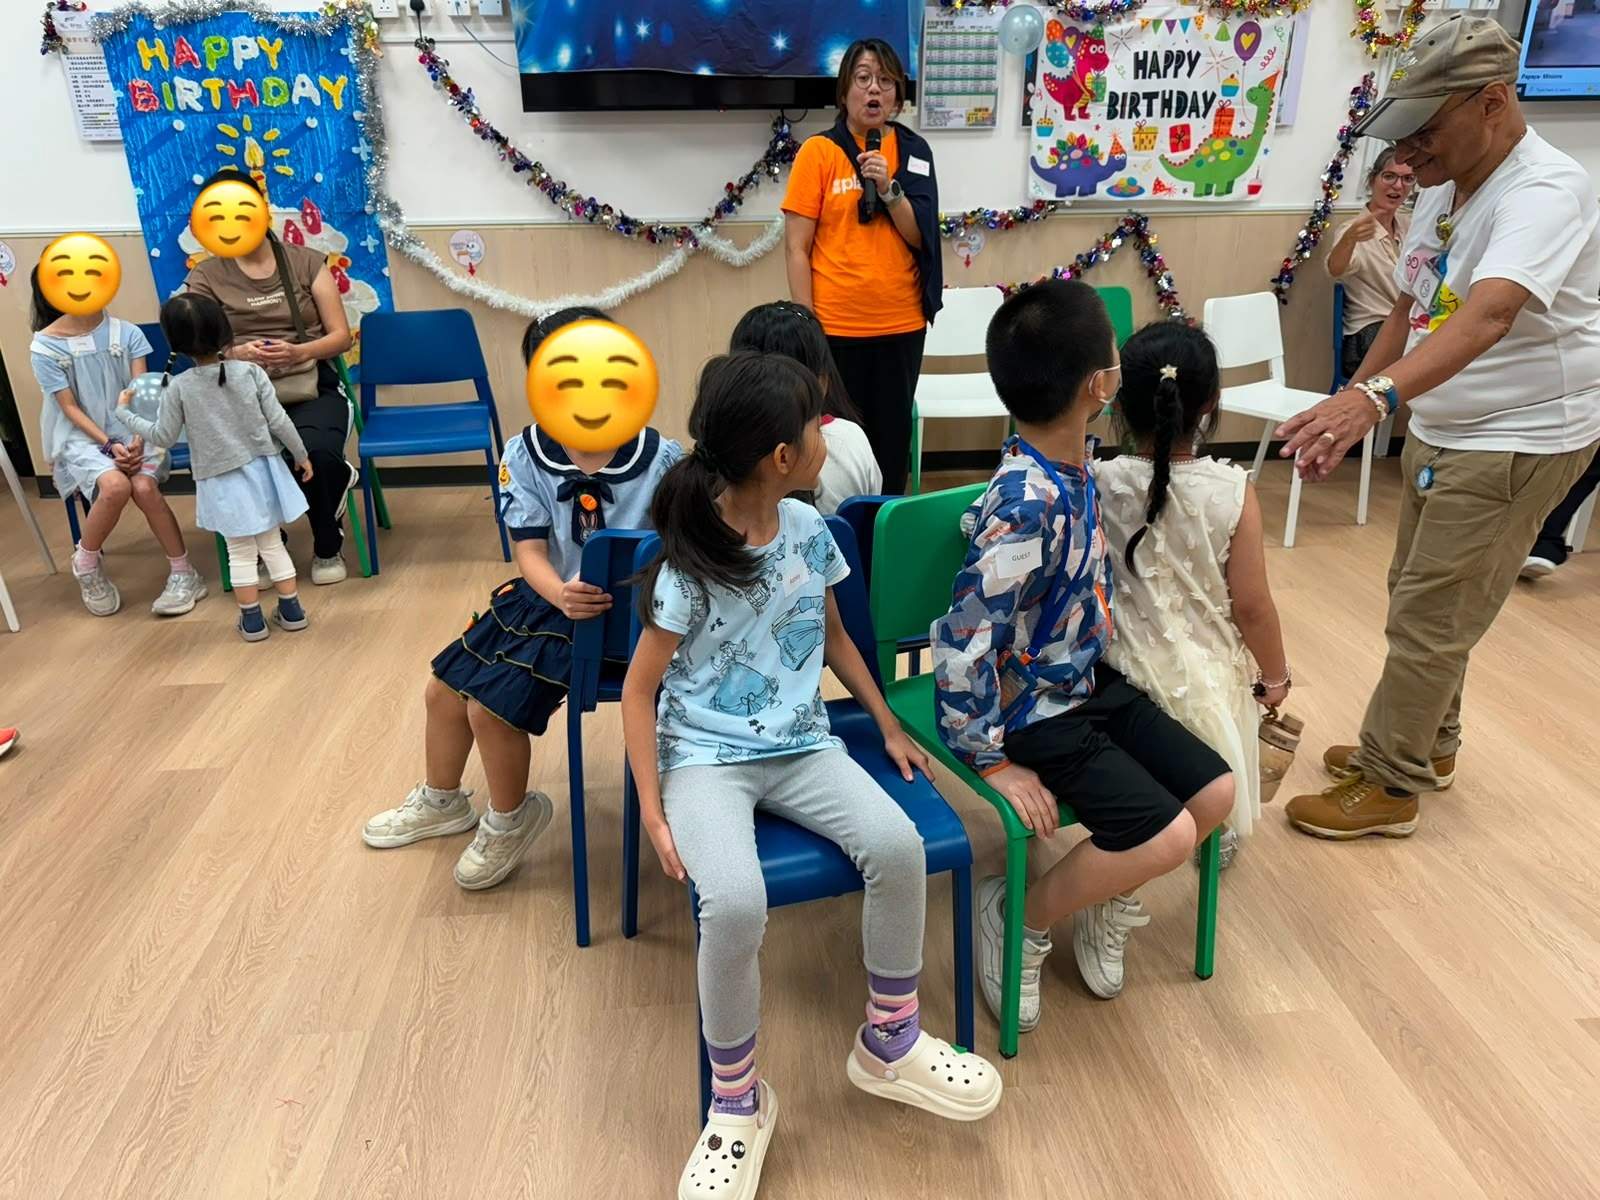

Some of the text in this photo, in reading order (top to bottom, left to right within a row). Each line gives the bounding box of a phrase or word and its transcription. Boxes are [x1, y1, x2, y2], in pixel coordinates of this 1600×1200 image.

[136, 35, 284, 71] HAPPY
[1133, 49, 1202, 80] HAPPY
[128, 73, 348, 112] BIRTHDAY
[1106, 89, 1217, 120] BIRTHDAY
[1011, 551, 1031, 562] GUEST
